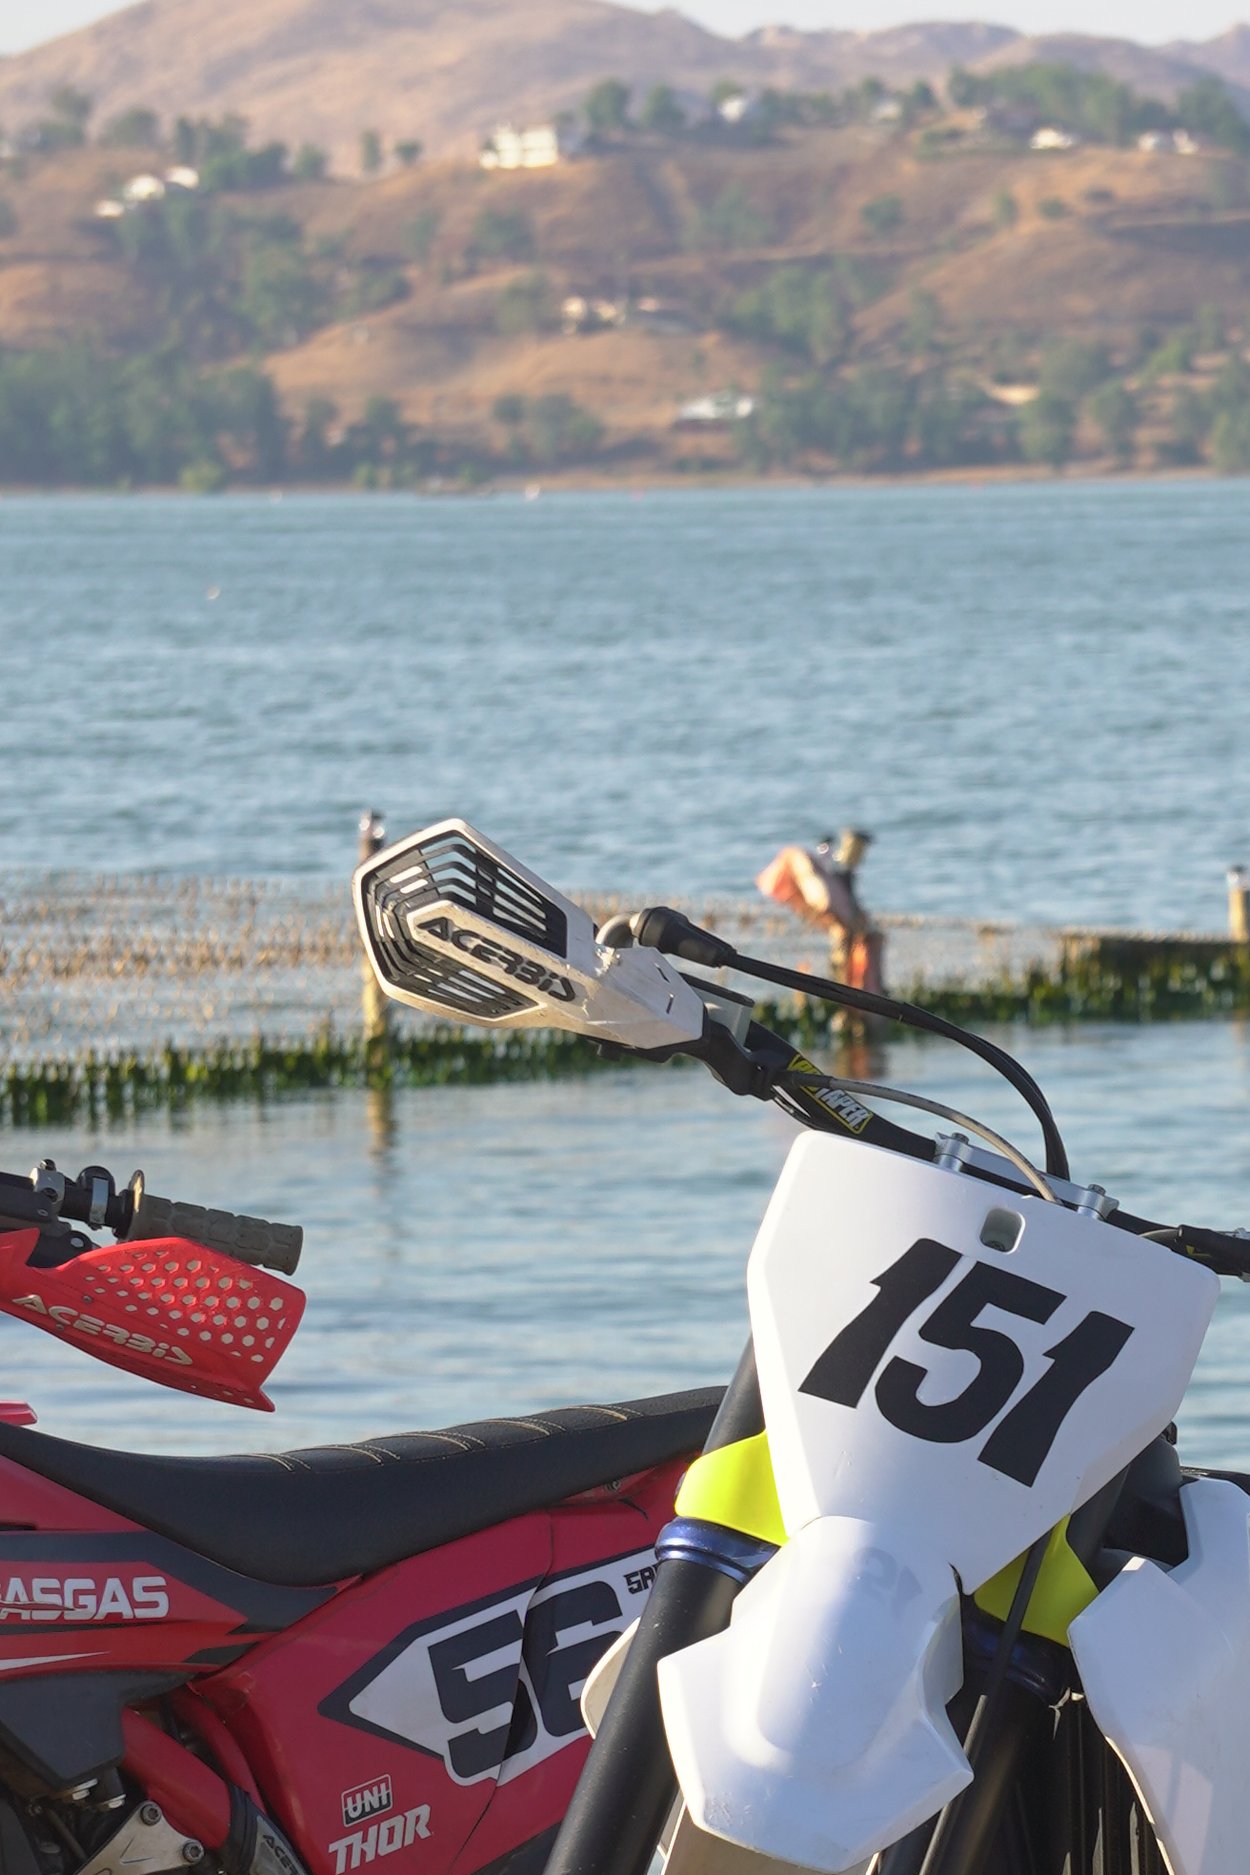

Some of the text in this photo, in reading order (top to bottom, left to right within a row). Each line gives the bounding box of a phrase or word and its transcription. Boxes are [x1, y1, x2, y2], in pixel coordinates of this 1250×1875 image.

[416, 916, 576, 1002] ACERBIS
[12, 1294, 193, 1366] ACERBIS
[797, 1237, 1136, 1487] 151
[0, 1576, 169, 1620] ASGAS
[428, 1581, 625, 1778] 56
[346, 1782, 388, 1818] UNI
[328, 1803, 432, 1875] THOR
